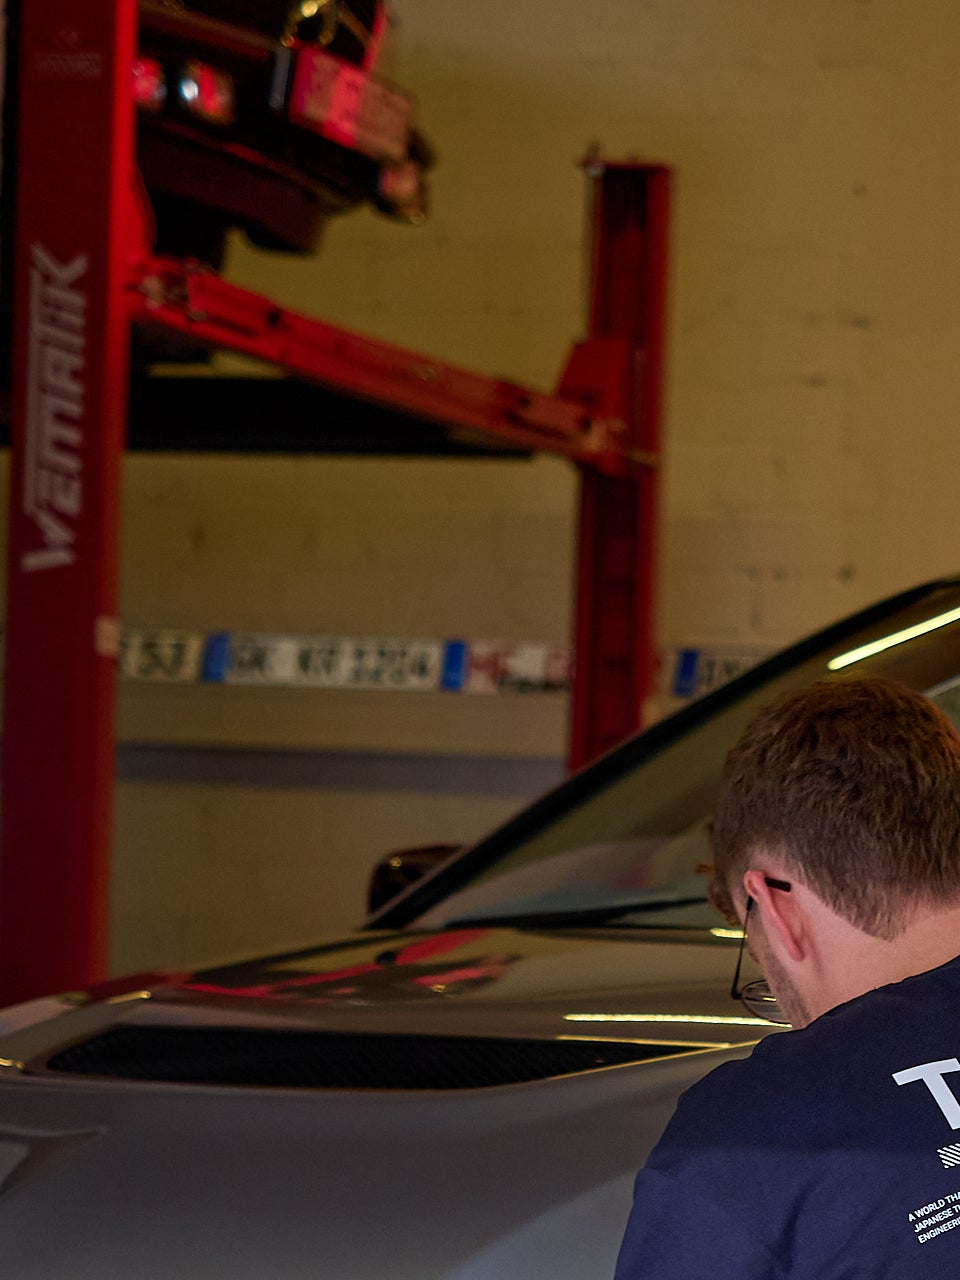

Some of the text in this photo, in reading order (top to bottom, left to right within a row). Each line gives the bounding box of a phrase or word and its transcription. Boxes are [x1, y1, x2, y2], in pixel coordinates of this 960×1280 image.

[908, 1213, 917, 1222] A
[914, 1199, 945, 1218] WORLD
[914, 1208, 955, 1233] JAPANESE
